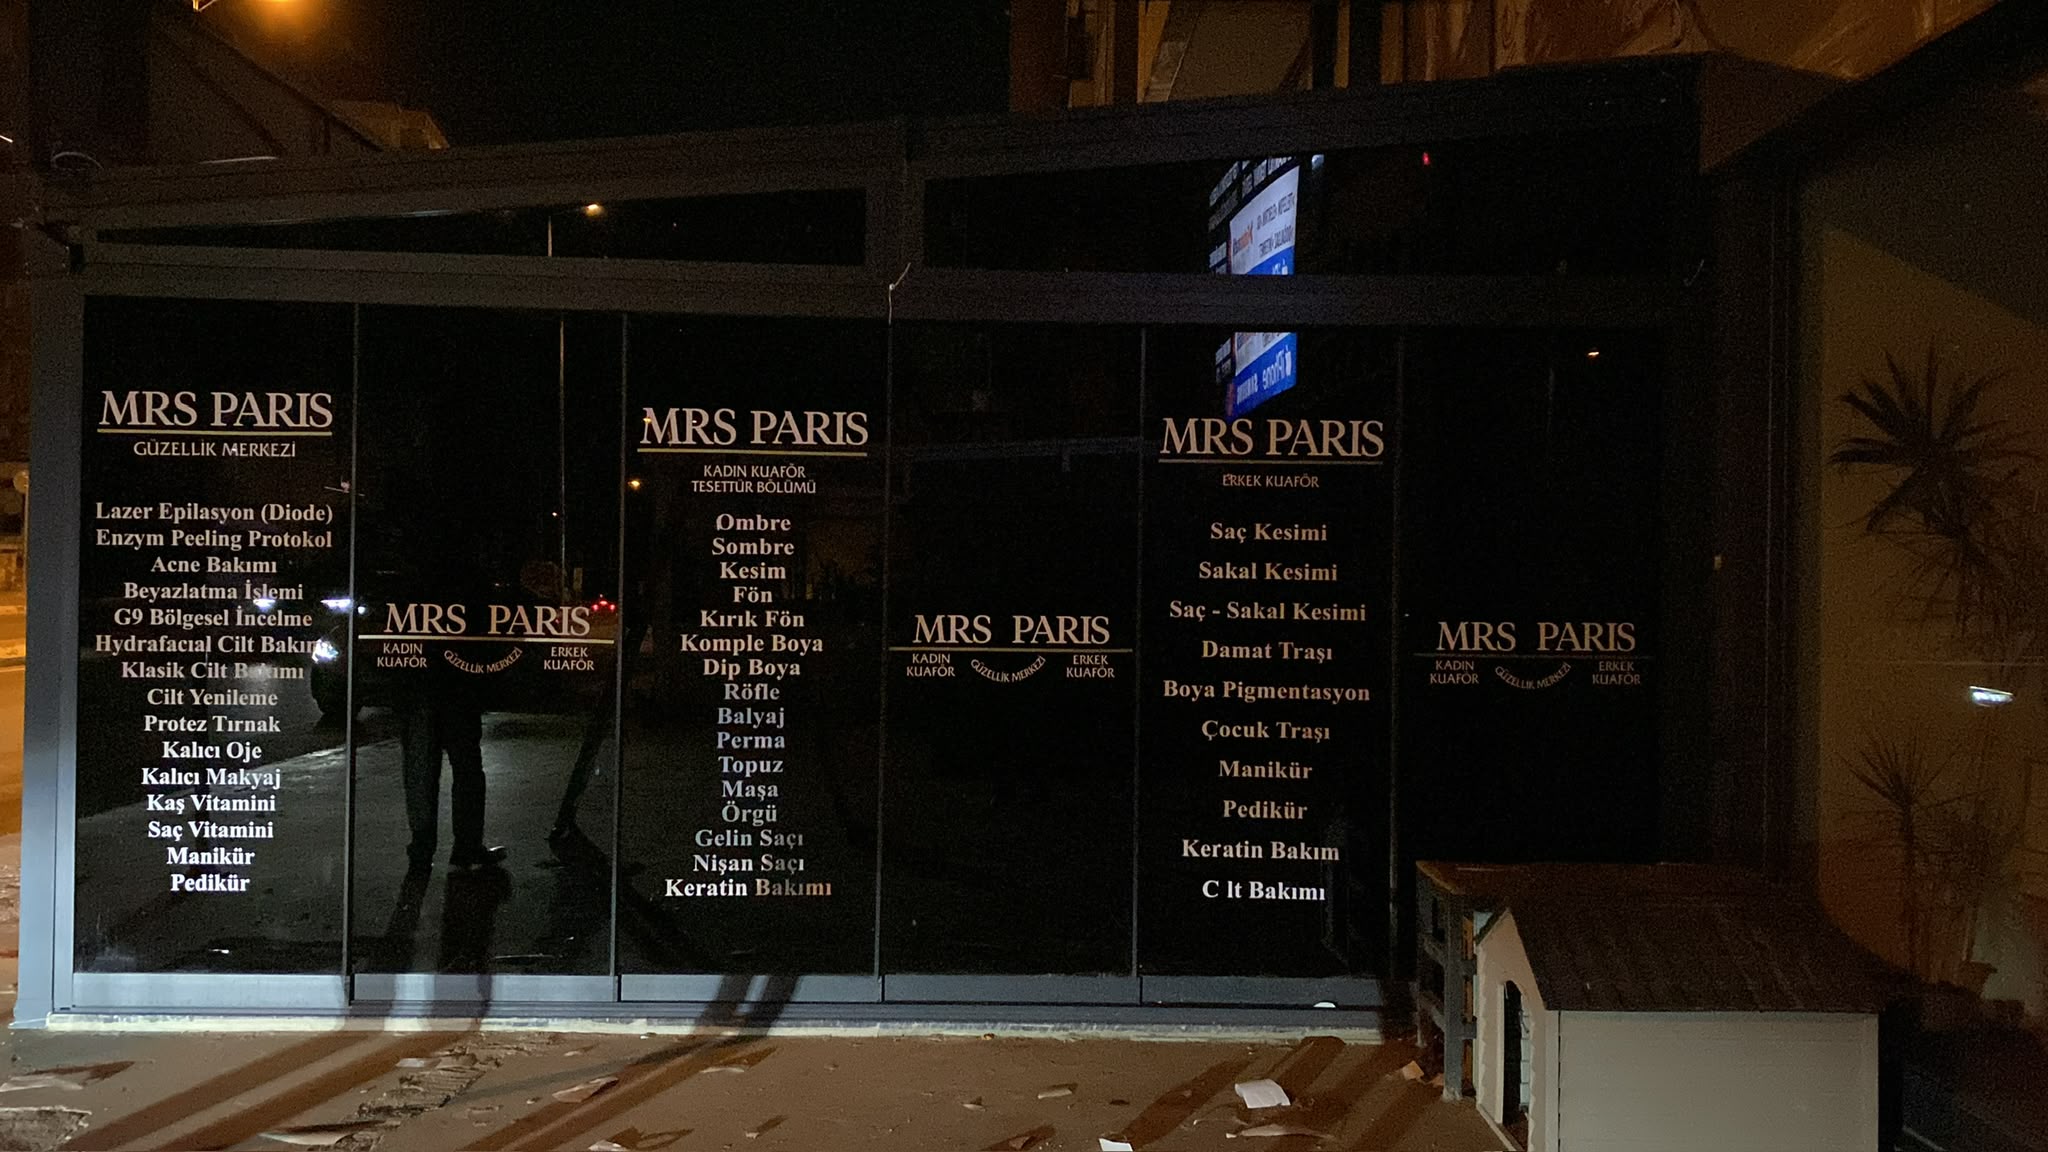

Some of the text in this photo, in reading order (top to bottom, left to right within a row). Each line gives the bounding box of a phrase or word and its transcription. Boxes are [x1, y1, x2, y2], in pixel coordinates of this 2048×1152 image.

[99, 390, 333, 427] MRS PARIS
[640, 408, 868, 446] MRS PARIS
[1160, 418, 1384, 457] MRS PARIS
[134, 439, 295, 457] GÜZELLİK MERKEZİ
[704, 463, 806, 478] KADIN KUAFÖR
[691, 479, 816, 493] TESETTÜR BÖLÜMÜ
[1223, 474, 1319, 488] ERKEK KUAFÖR
[96, 502, 333, 523] Lazer Epilasyon (Diode)
[716, 514, 791, 531] Ombre
[96, 530, 332, 550] Enzym Peeling Protokol
[1211, 522, 1327, 543] Saç Kesimi
[712, 538, 794, 555] Sombre
[151, 557, 276, 573] Acne Bakımı
[720, 562, 786, 579] Kesim
[1199, 562, 1337, 581] Sakal Kesimi
[124, 583, 237, 602] Beyazlatma
[733, 587, 772, 603] Fön
[114, 605, 312, 629] G9 Bölgesel İncelme
[384, 603, 590, 636] MRS PARIS
[701, 610, 804, 627] Kırık Fön
[1170, 601, 1206, 621] Saç
[1227, 602, 1285, 619] Sakal
[1293, 602, 1366, 621] Kesimi
[912, 615, 1110, 644] MRS PARIS
[1436, 621, 1635, 652] MRS PARIS
[218, 637, 254, 652] Cilt
[384, 643, 423, 654] KADIN
[551, 647, 588, 657] ERKEK
[681, 634, 823, 655] Komple Boya
[1202, 640, 1332, 664] Damat Traşı
[377, 654, 427, 668] KUAFÖR
[544, 657, 594, 671] KUAFÖR
[912, 653, 950, 664] KADIN
[1073, 655, 1108, 665] ERKEK
[1436, 660, 1474, 671] KADIN
[1599, 662, 1634, 671] ERKEK
[122, 662, 184, 679] Klasik
[191, 663, 227, 679] Cilt
[704, 659, 800, 680] Dip Boya
[907, 664, 955, 677] KUAFÖR
[1066, 665, 1115, 678] KUAFÖR
[1430, 671, 1479, 684] KUAFÖR
[1592, 672, 1641, 685] KUAFÖR
[147, 689, 278, 706] Cilt Yenileme
[724, 683, 780, 700] Röfle
[1163, 680, 1370, 704] Boya Pigmentasyon
[144, 715, 281, 732] Protez Tırnak
[718, 707, 785, 728] Balyaj
[717, 732, 785, 749] Perma
[1202, 720, 1330, 743] Çocuk Traşı
[163, 742, 262, 762] Kalıcı Oje
[718, 756, 783, 777] Topuz
[1219, 760, 1313, 779] Manikür
[141, 768, 281, 790] Kalıcı Makyaj
[722, 781, 778, 802] Maşa
[147, 795, 275, 814] Kaş Vitamini
[722, 801, 777, 826] Örgü
[1223, 800, 1308, 819] Pedikür
[148, 821, 273, 841] Saç Vitamini
[695, 829, 803, 849] Gelin Saçı
[167, 847, 255, 865] Manikür
[1182, 839, 1340, 860] Keratin Bakım
[693, 855, 804, 875] Nişan Saçı
[170, 874, 250, 892] Pedikür
[665, 879, 832, 896] Keratin Bakımı
[1249, 881, 1325, 900] Bakımı
